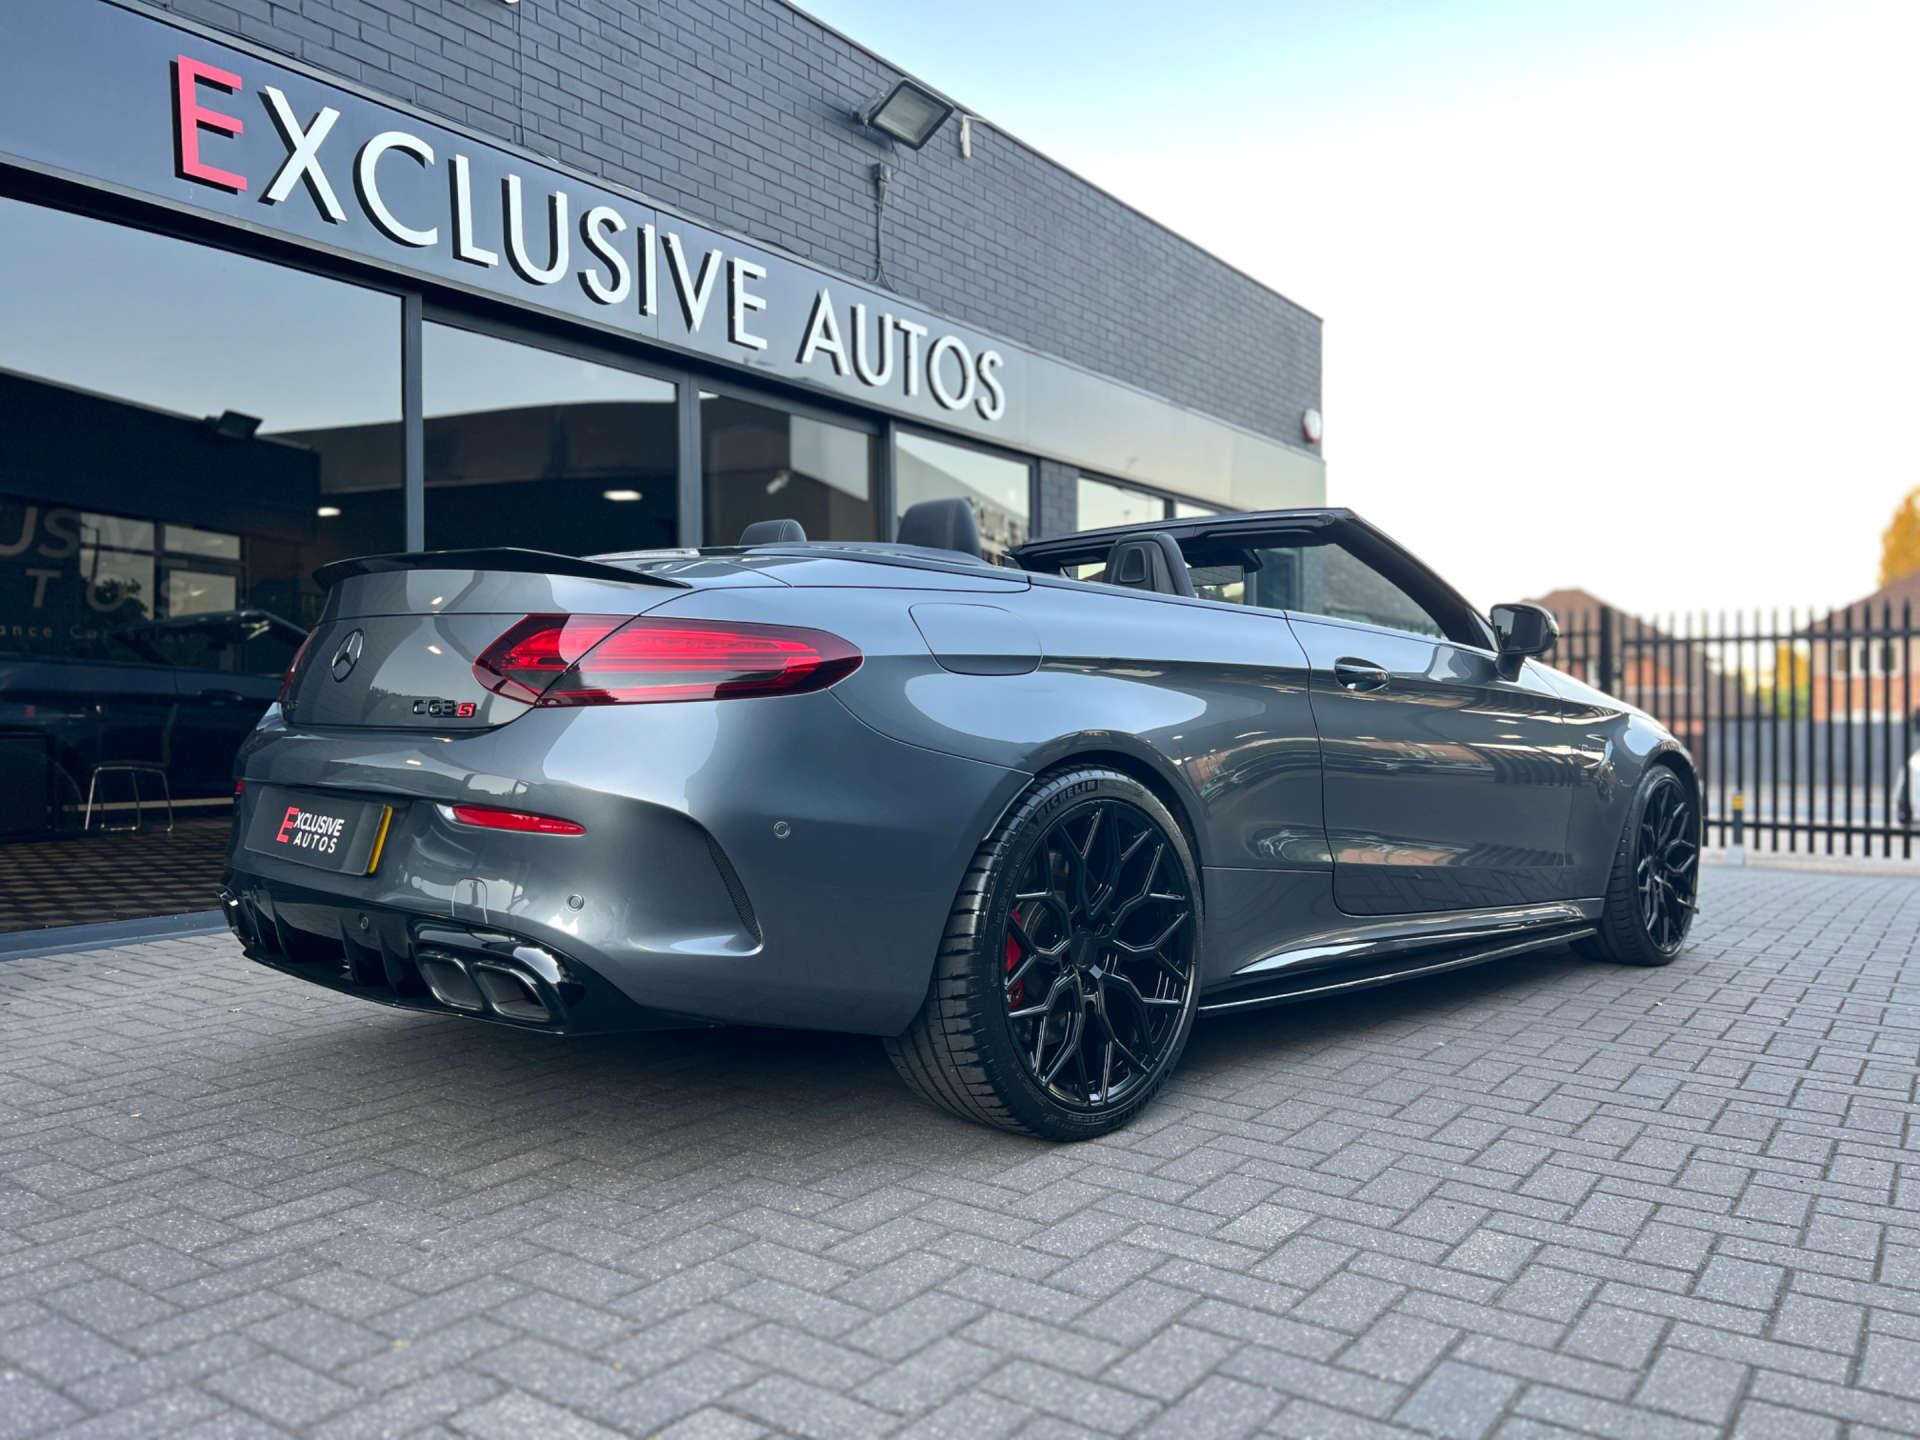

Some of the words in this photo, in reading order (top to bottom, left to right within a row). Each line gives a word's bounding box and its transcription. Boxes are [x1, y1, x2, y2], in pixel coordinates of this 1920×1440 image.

[174, 54, 768, 351] EXCLUSIVE
[799, 287, 1004, 421] AUTOS
[276, 806, 345, 844] EXCLUSIVE
[292, 831, 338, 854] AUTOS
